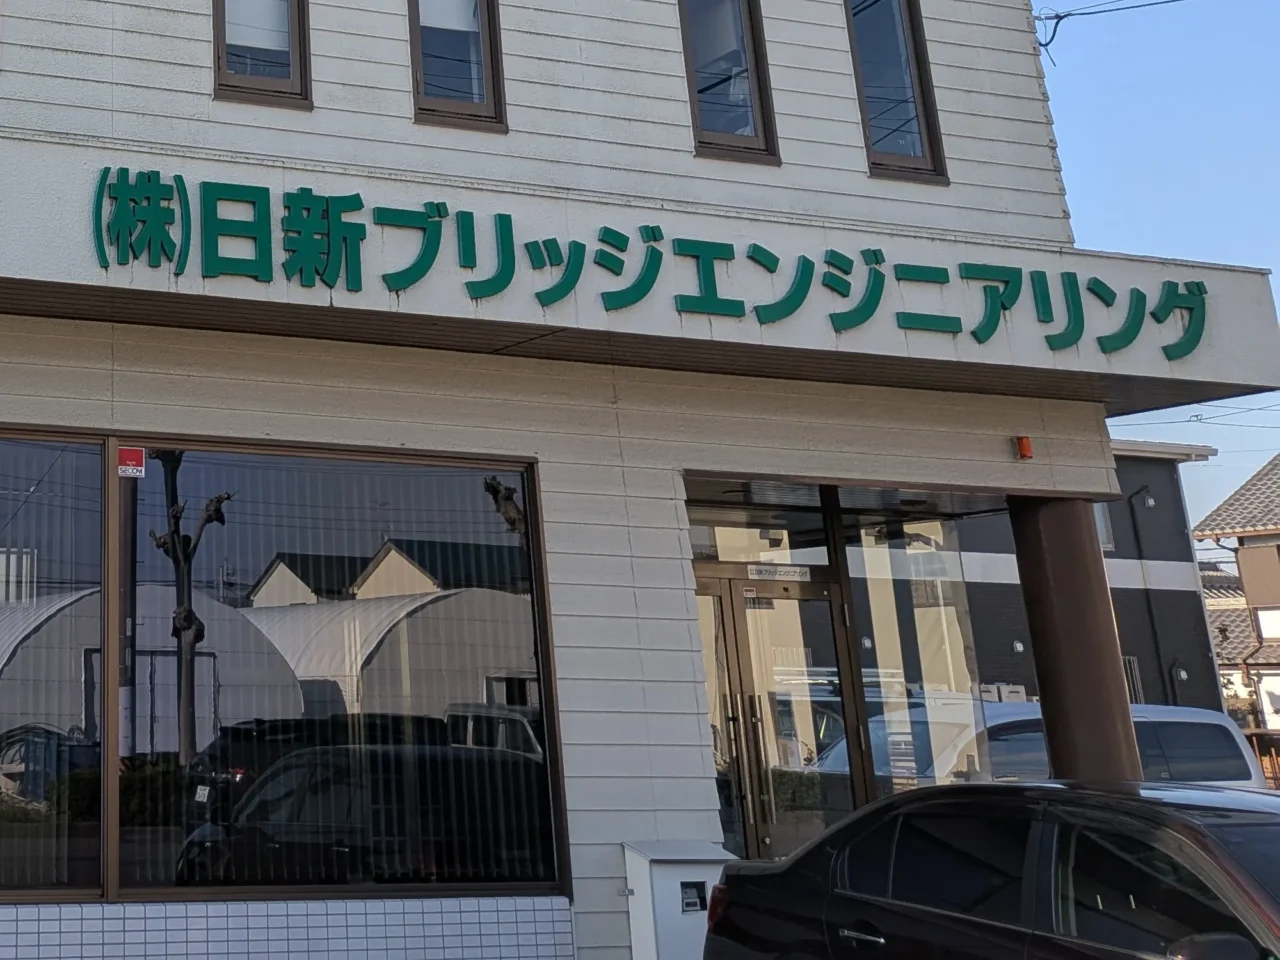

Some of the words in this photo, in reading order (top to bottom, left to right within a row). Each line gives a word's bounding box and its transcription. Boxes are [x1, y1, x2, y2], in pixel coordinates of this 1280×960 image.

[92, 166, 1206, 361] (株)日新ブリッジエンジニアリング
[119, 467, 143, 475] SECOM
